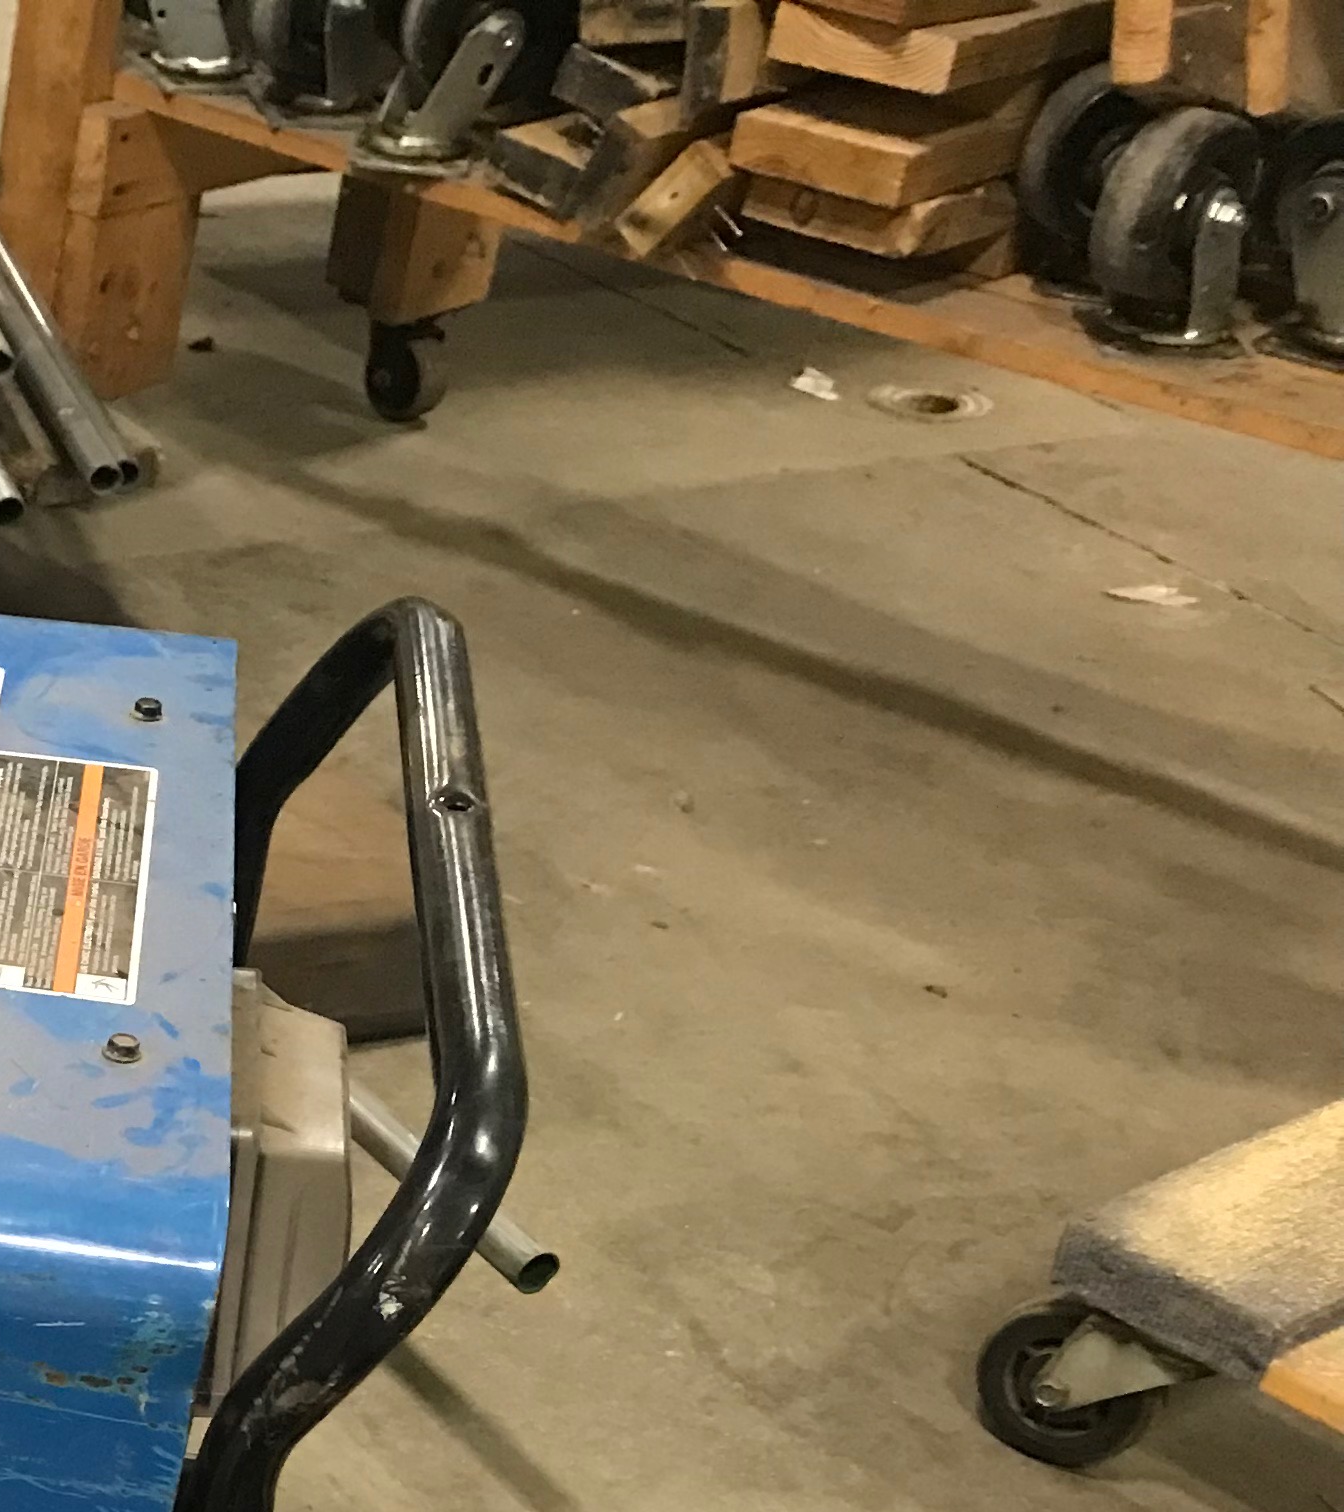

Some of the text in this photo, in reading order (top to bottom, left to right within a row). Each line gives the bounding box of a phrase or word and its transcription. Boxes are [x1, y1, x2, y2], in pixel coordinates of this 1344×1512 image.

[69, 836, 91, 896] MISE EN GARDE
